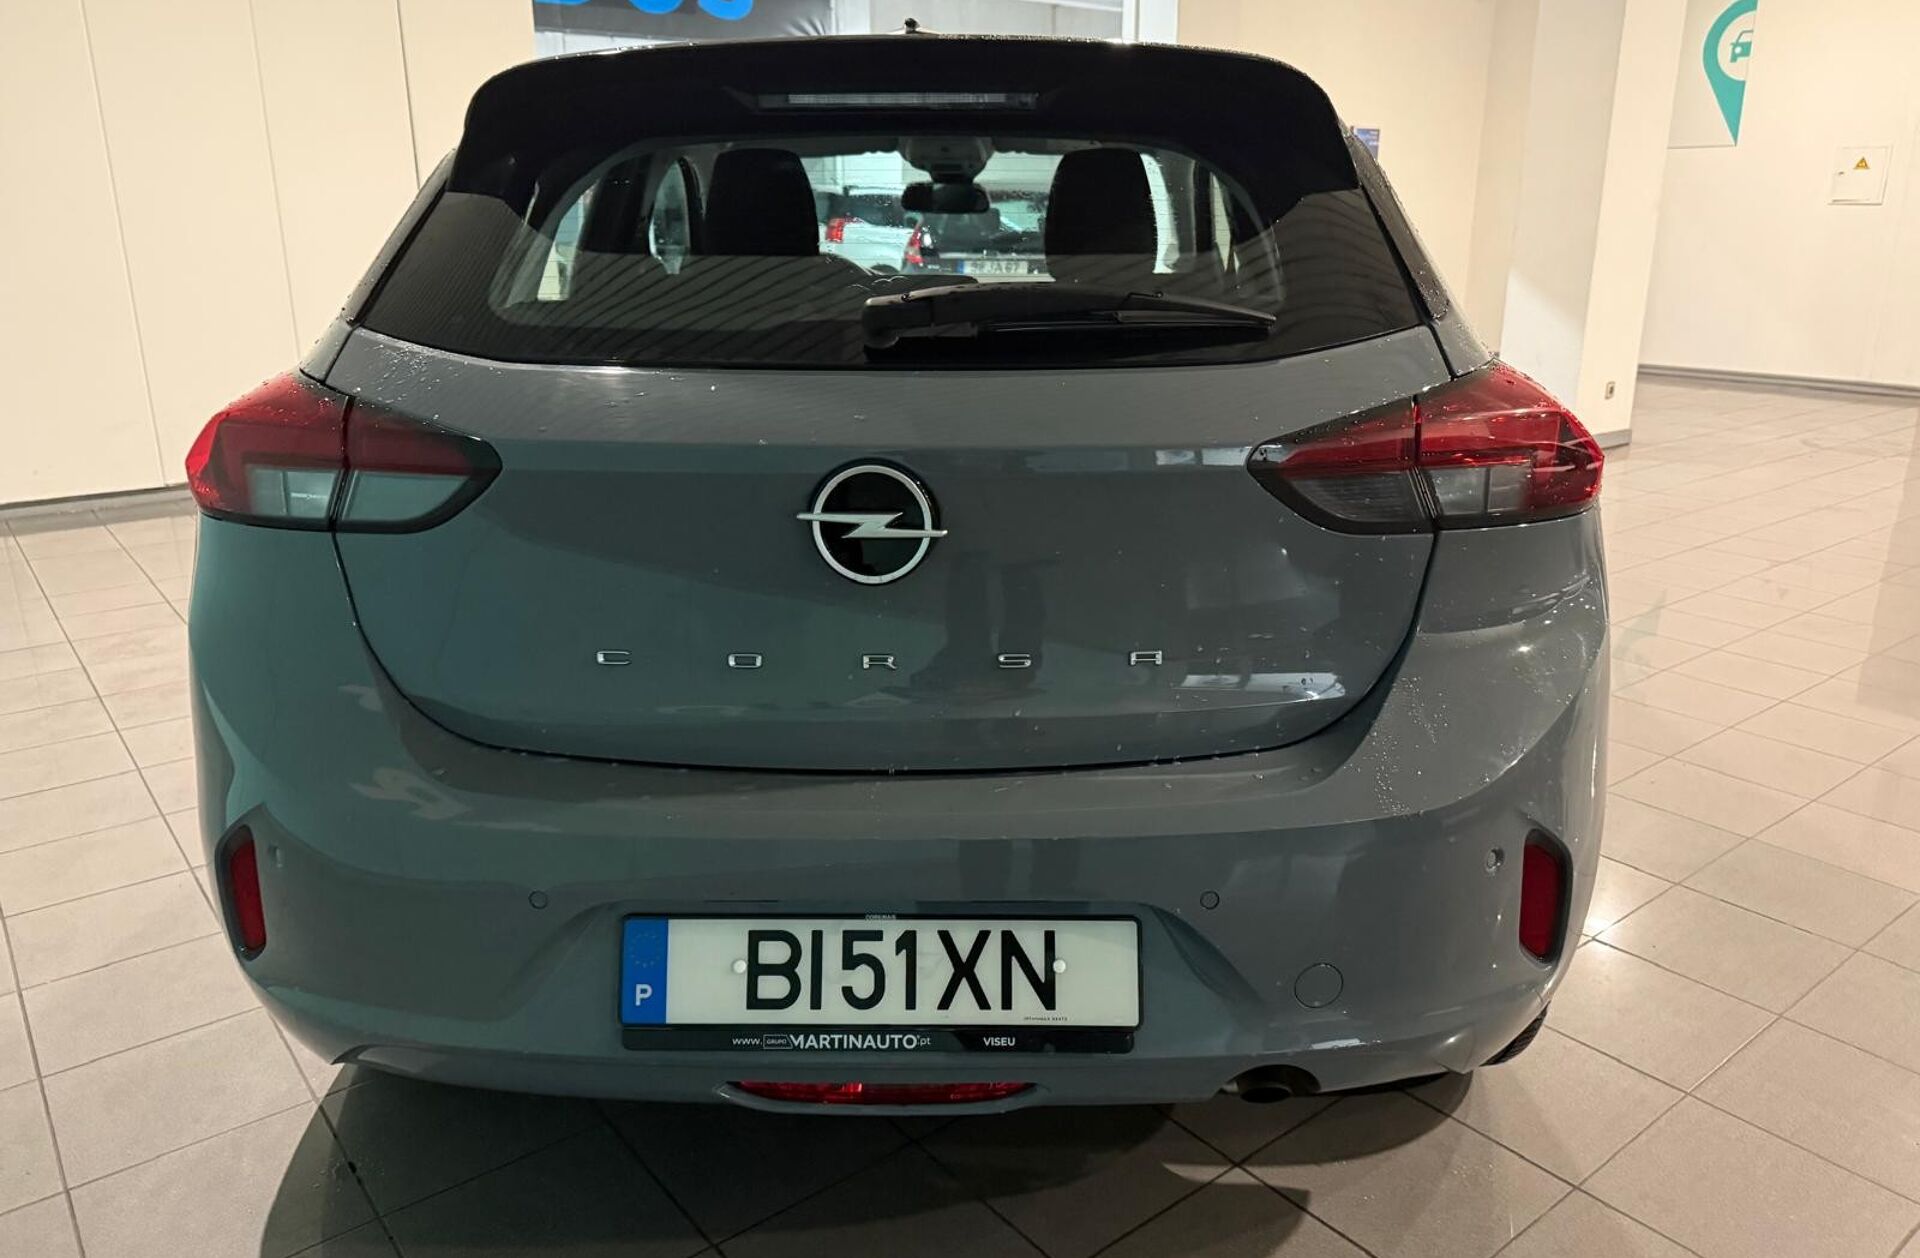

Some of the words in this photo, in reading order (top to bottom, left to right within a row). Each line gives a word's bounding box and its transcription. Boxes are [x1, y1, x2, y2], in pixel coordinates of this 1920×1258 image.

[596, 649, 1163, 670] CORSA
[635, 985, 653, 1006] P
[983, 1036, 1016, 1047] VISEU
